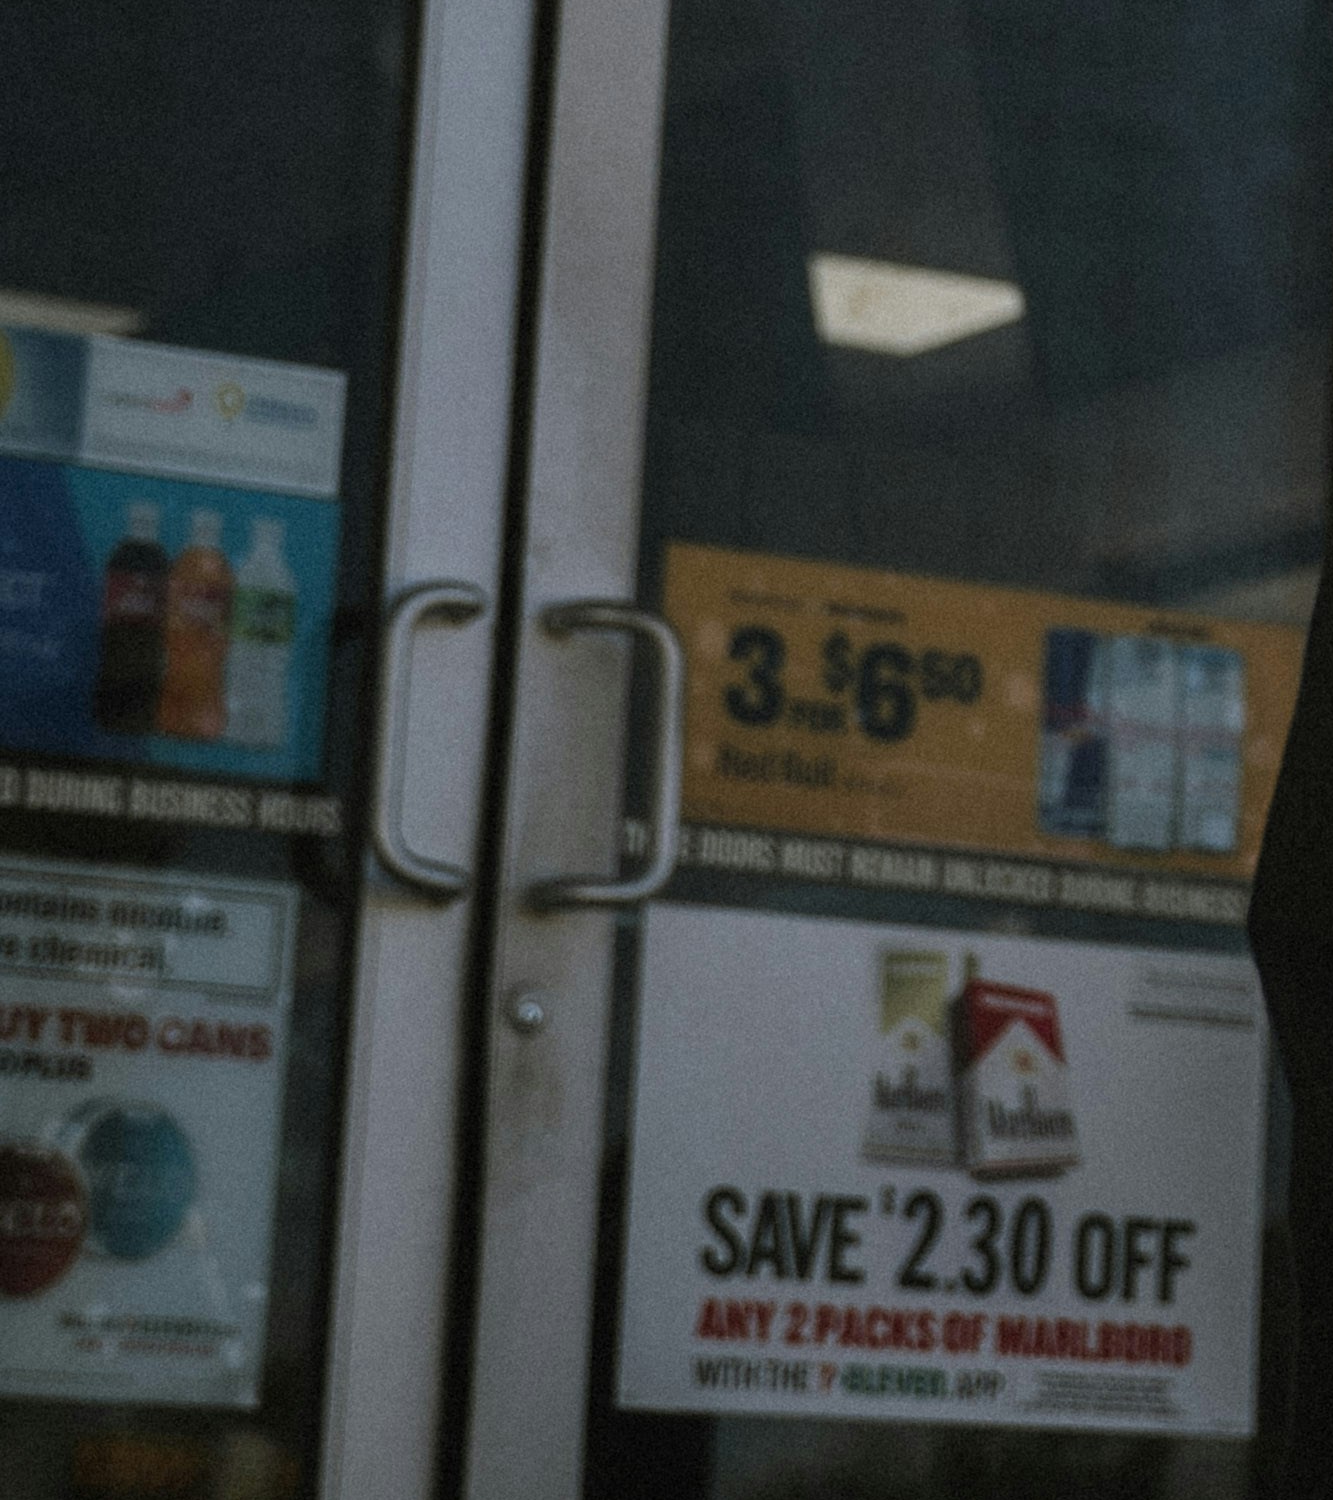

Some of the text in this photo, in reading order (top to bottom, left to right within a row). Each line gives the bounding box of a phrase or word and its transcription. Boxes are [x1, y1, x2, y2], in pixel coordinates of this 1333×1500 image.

[724, 625, 785, 727] 3
[57, 1005, 149, 1052] TWO
[156, 1013, 273, 1064] CANS
[702, 1184, 1196, 1303] SAVE $2.30 OFF
[698, 1298, 1193, 1368] ANY 2 PACKS OF MARLBORO
